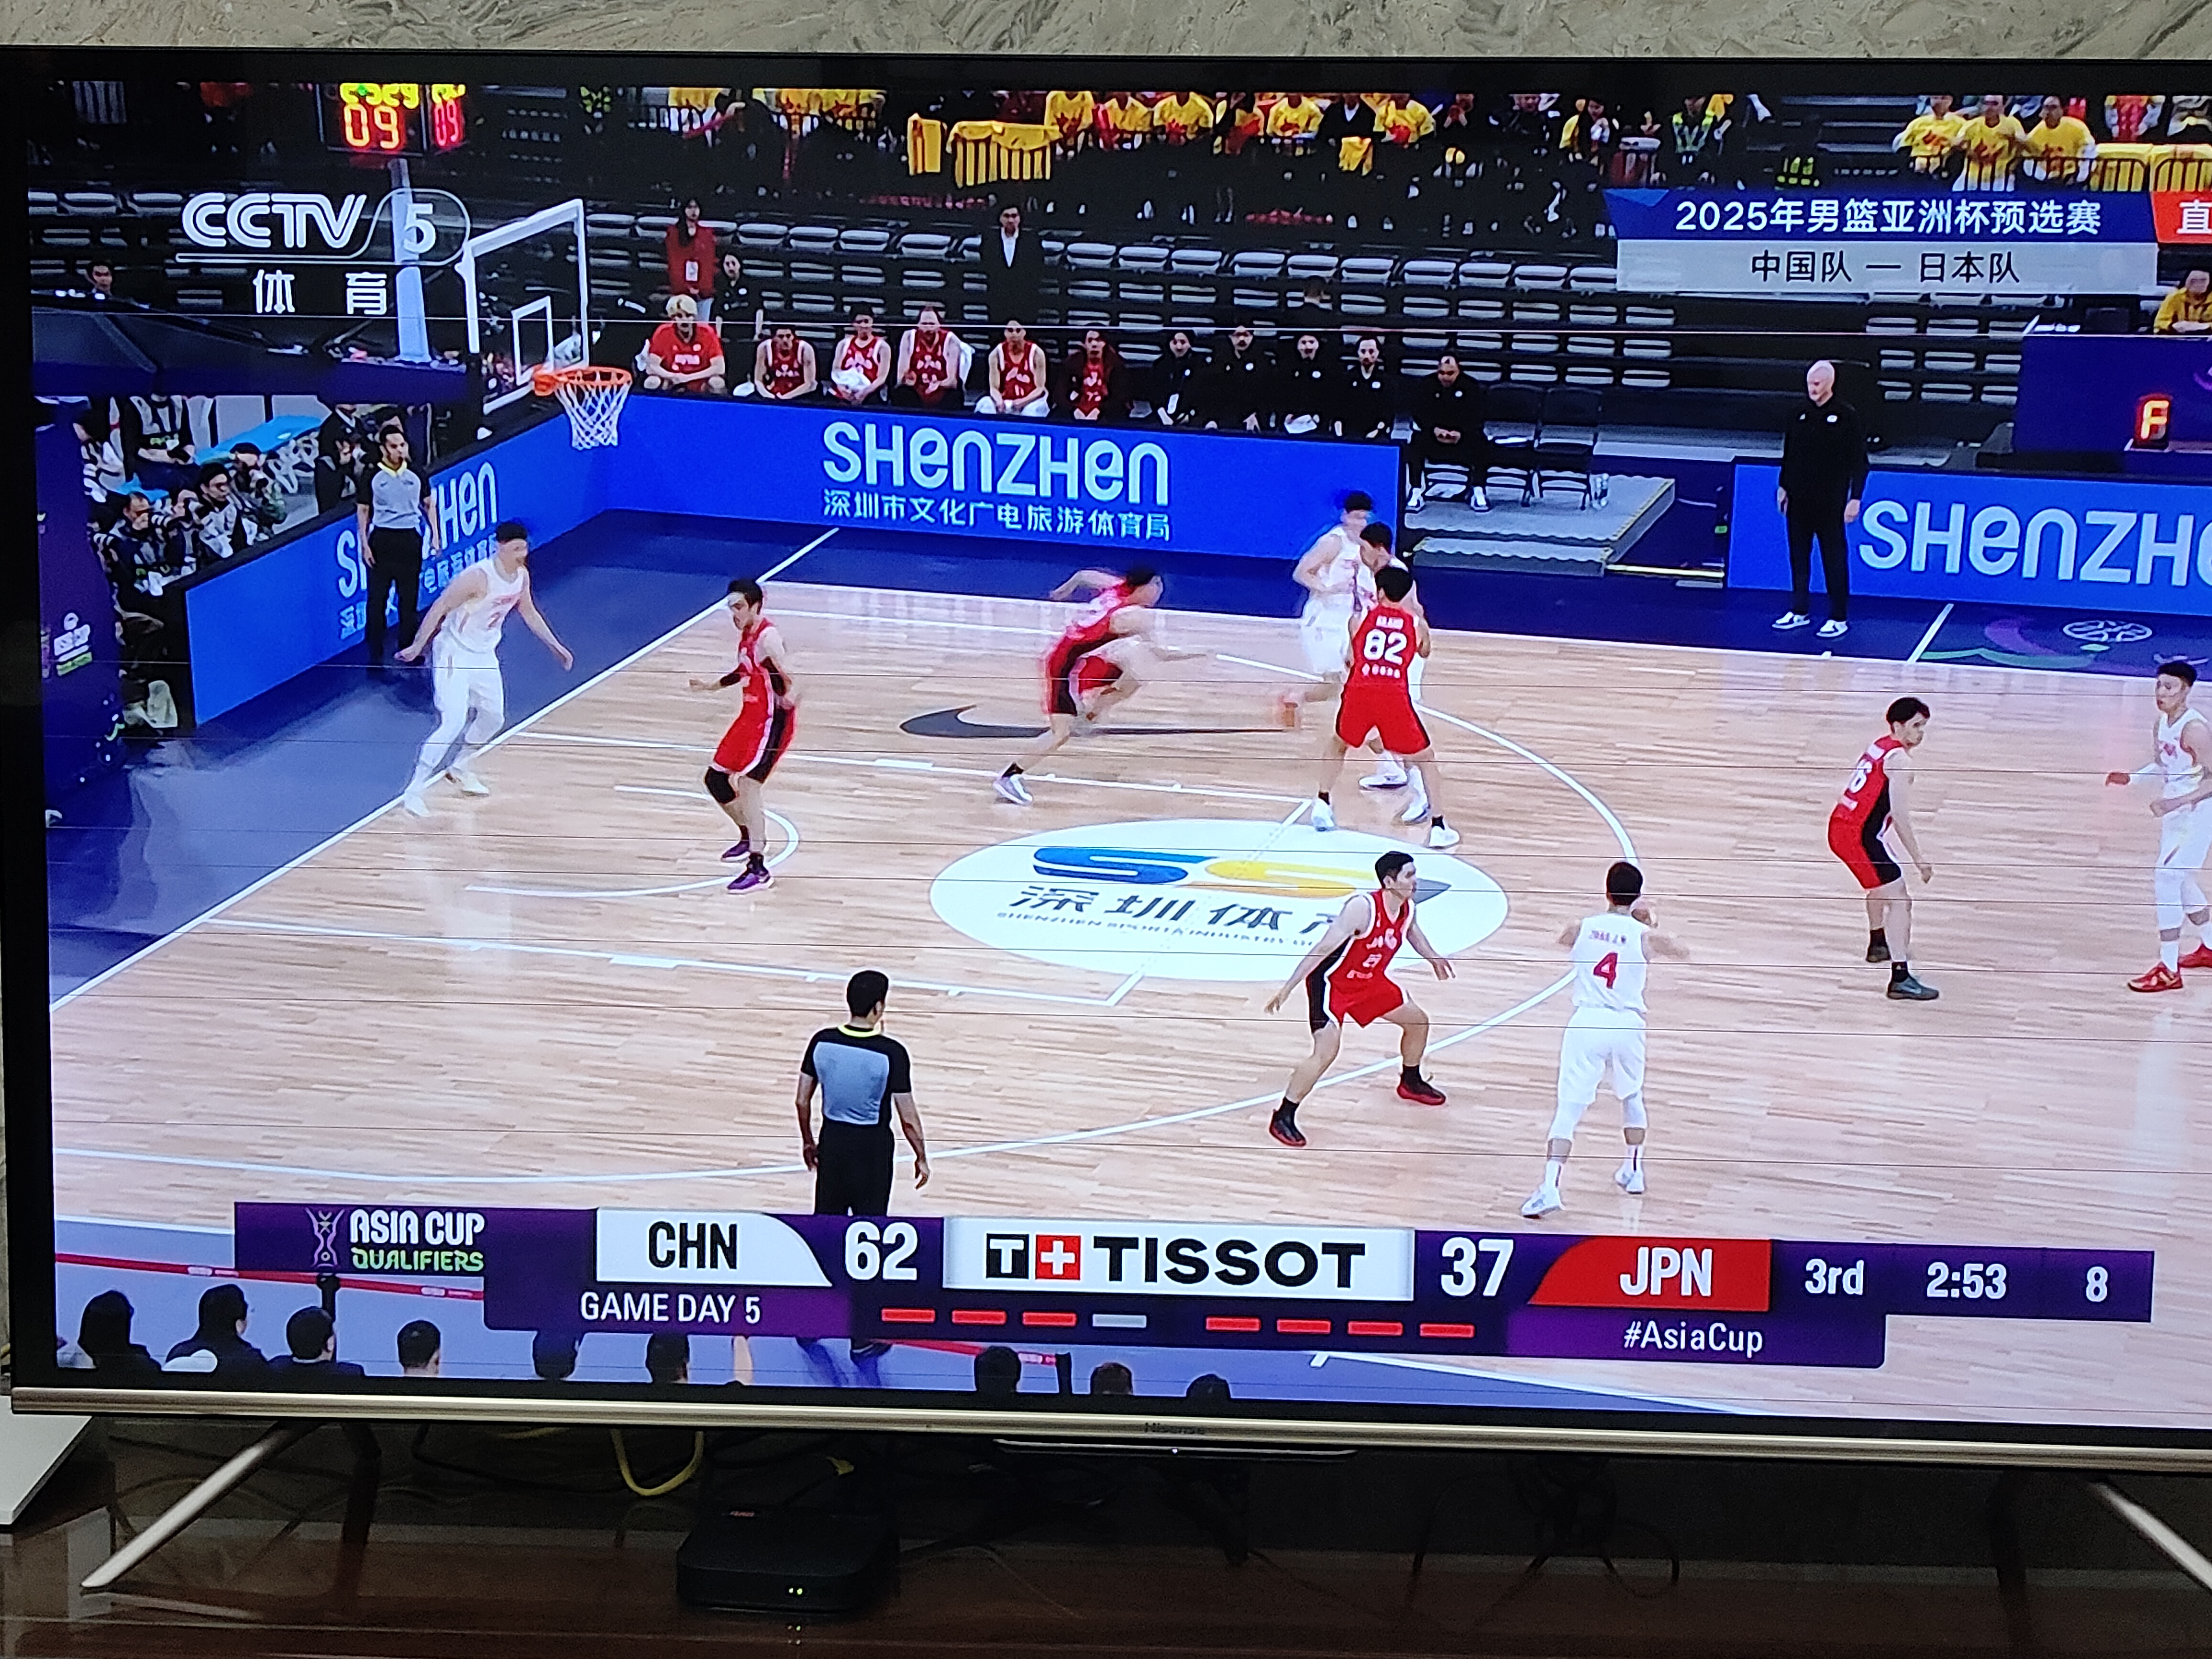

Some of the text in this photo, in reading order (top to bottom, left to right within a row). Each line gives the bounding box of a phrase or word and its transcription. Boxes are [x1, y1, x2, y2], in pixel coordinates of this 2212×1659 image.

[182, 193, 438, 254] CCTV 5
[1676, 198, 2101, 235] 2025年男篮亚洲杯预选赛
[823, 488, 1170, 541] 深圳市文化广电旅游体育局
[1593, 951, 1618, 989] 4
[350, 1209, 485, 1246] ASIA CUP
[649, 1221, 737, 1270] CHN
[350, 1247, 485, 1272] QUALIFIERS
[845, 1221, 918, 1281] 62
[1093, 1236, 1365, 1288] TISSOT
[1441, 1237, 1514, 1296] 37
[1620, 1247, 1713, 1296] JPN
[1805, 1259, 1864, 1295] 3rd
[1926, 1261, 2007, 1299] 2:53
[2086, 1266, 2108, 1302] 8
[581, 1292, 761, 1324] GAME DAY 5
[1624, 1320, 1763, 1358] #AsiaCup
